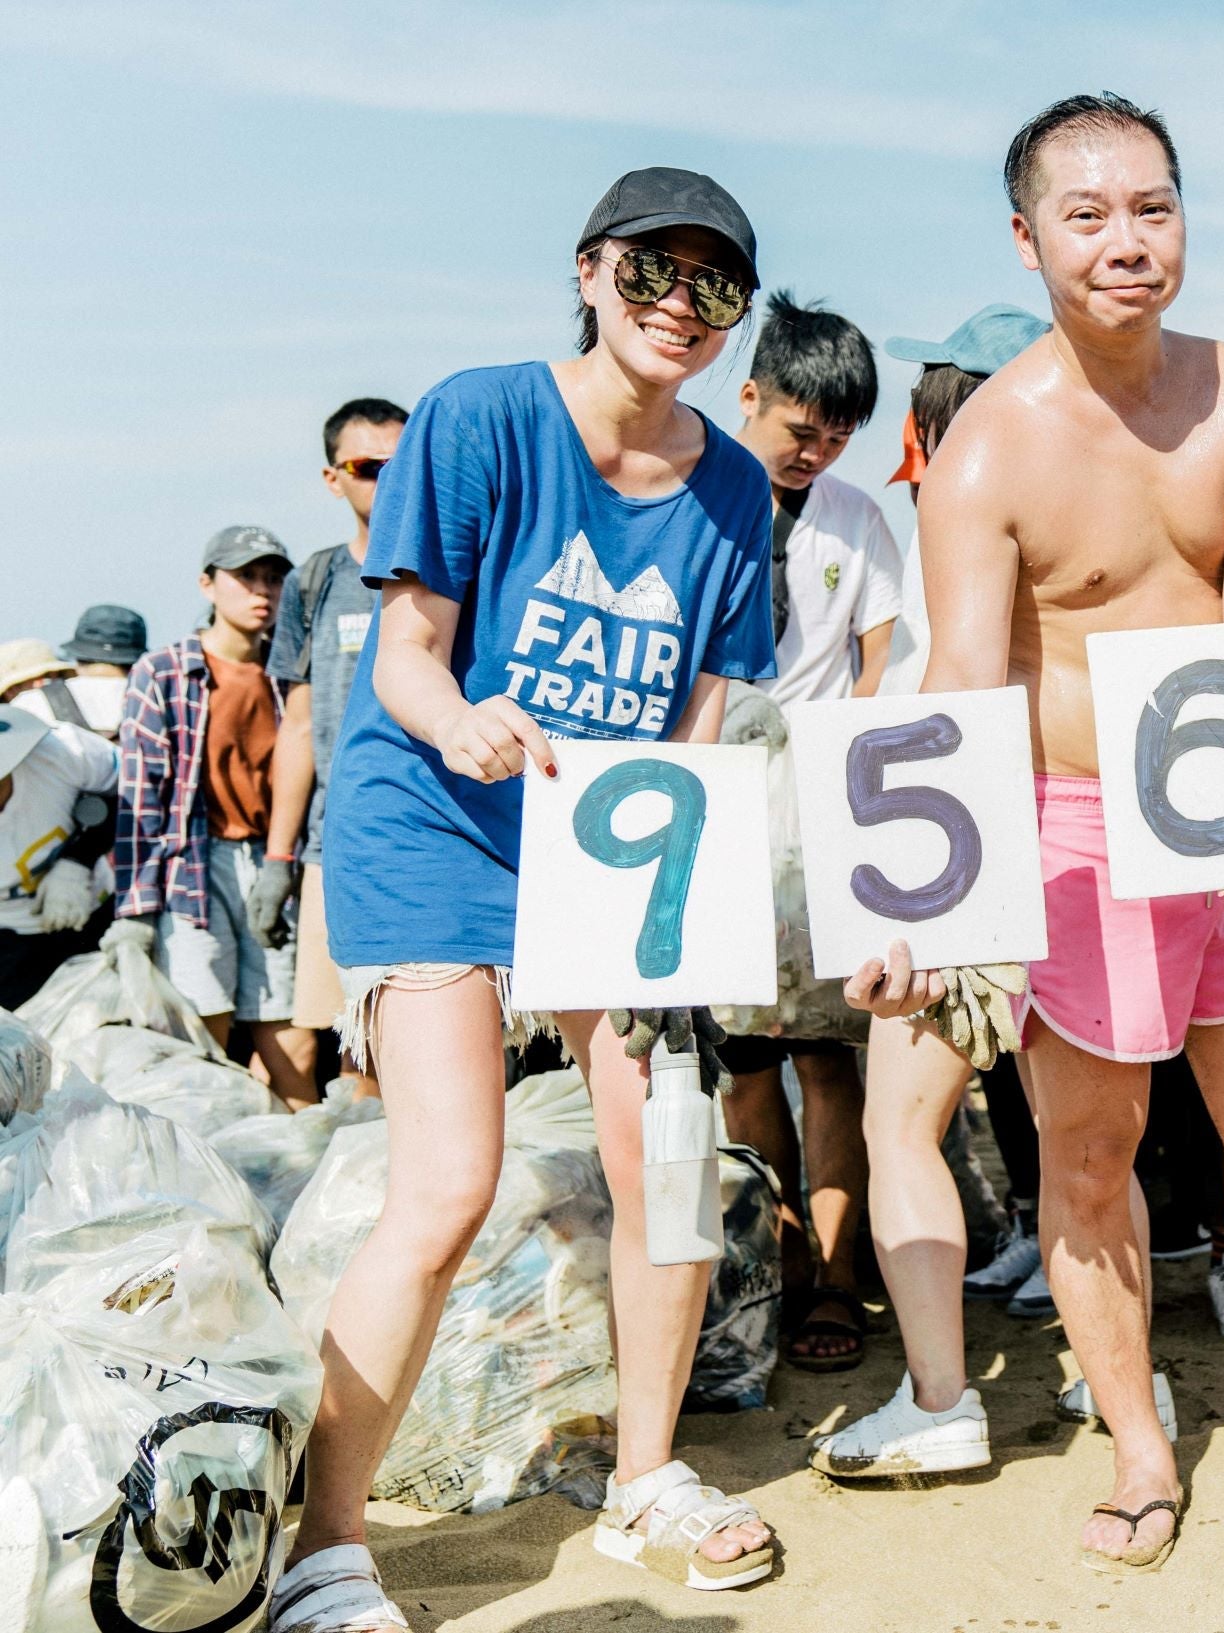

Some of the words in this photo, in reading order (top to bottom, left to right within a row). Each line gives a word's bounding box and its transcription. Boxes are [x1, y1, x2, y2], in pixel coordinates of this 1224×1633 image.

[502, 660, 669, 732] TRADE
[512, 598, 681, 689] FAIR
[572, 757, 707, 980] 9
[846, 712, 983, 922] 5
